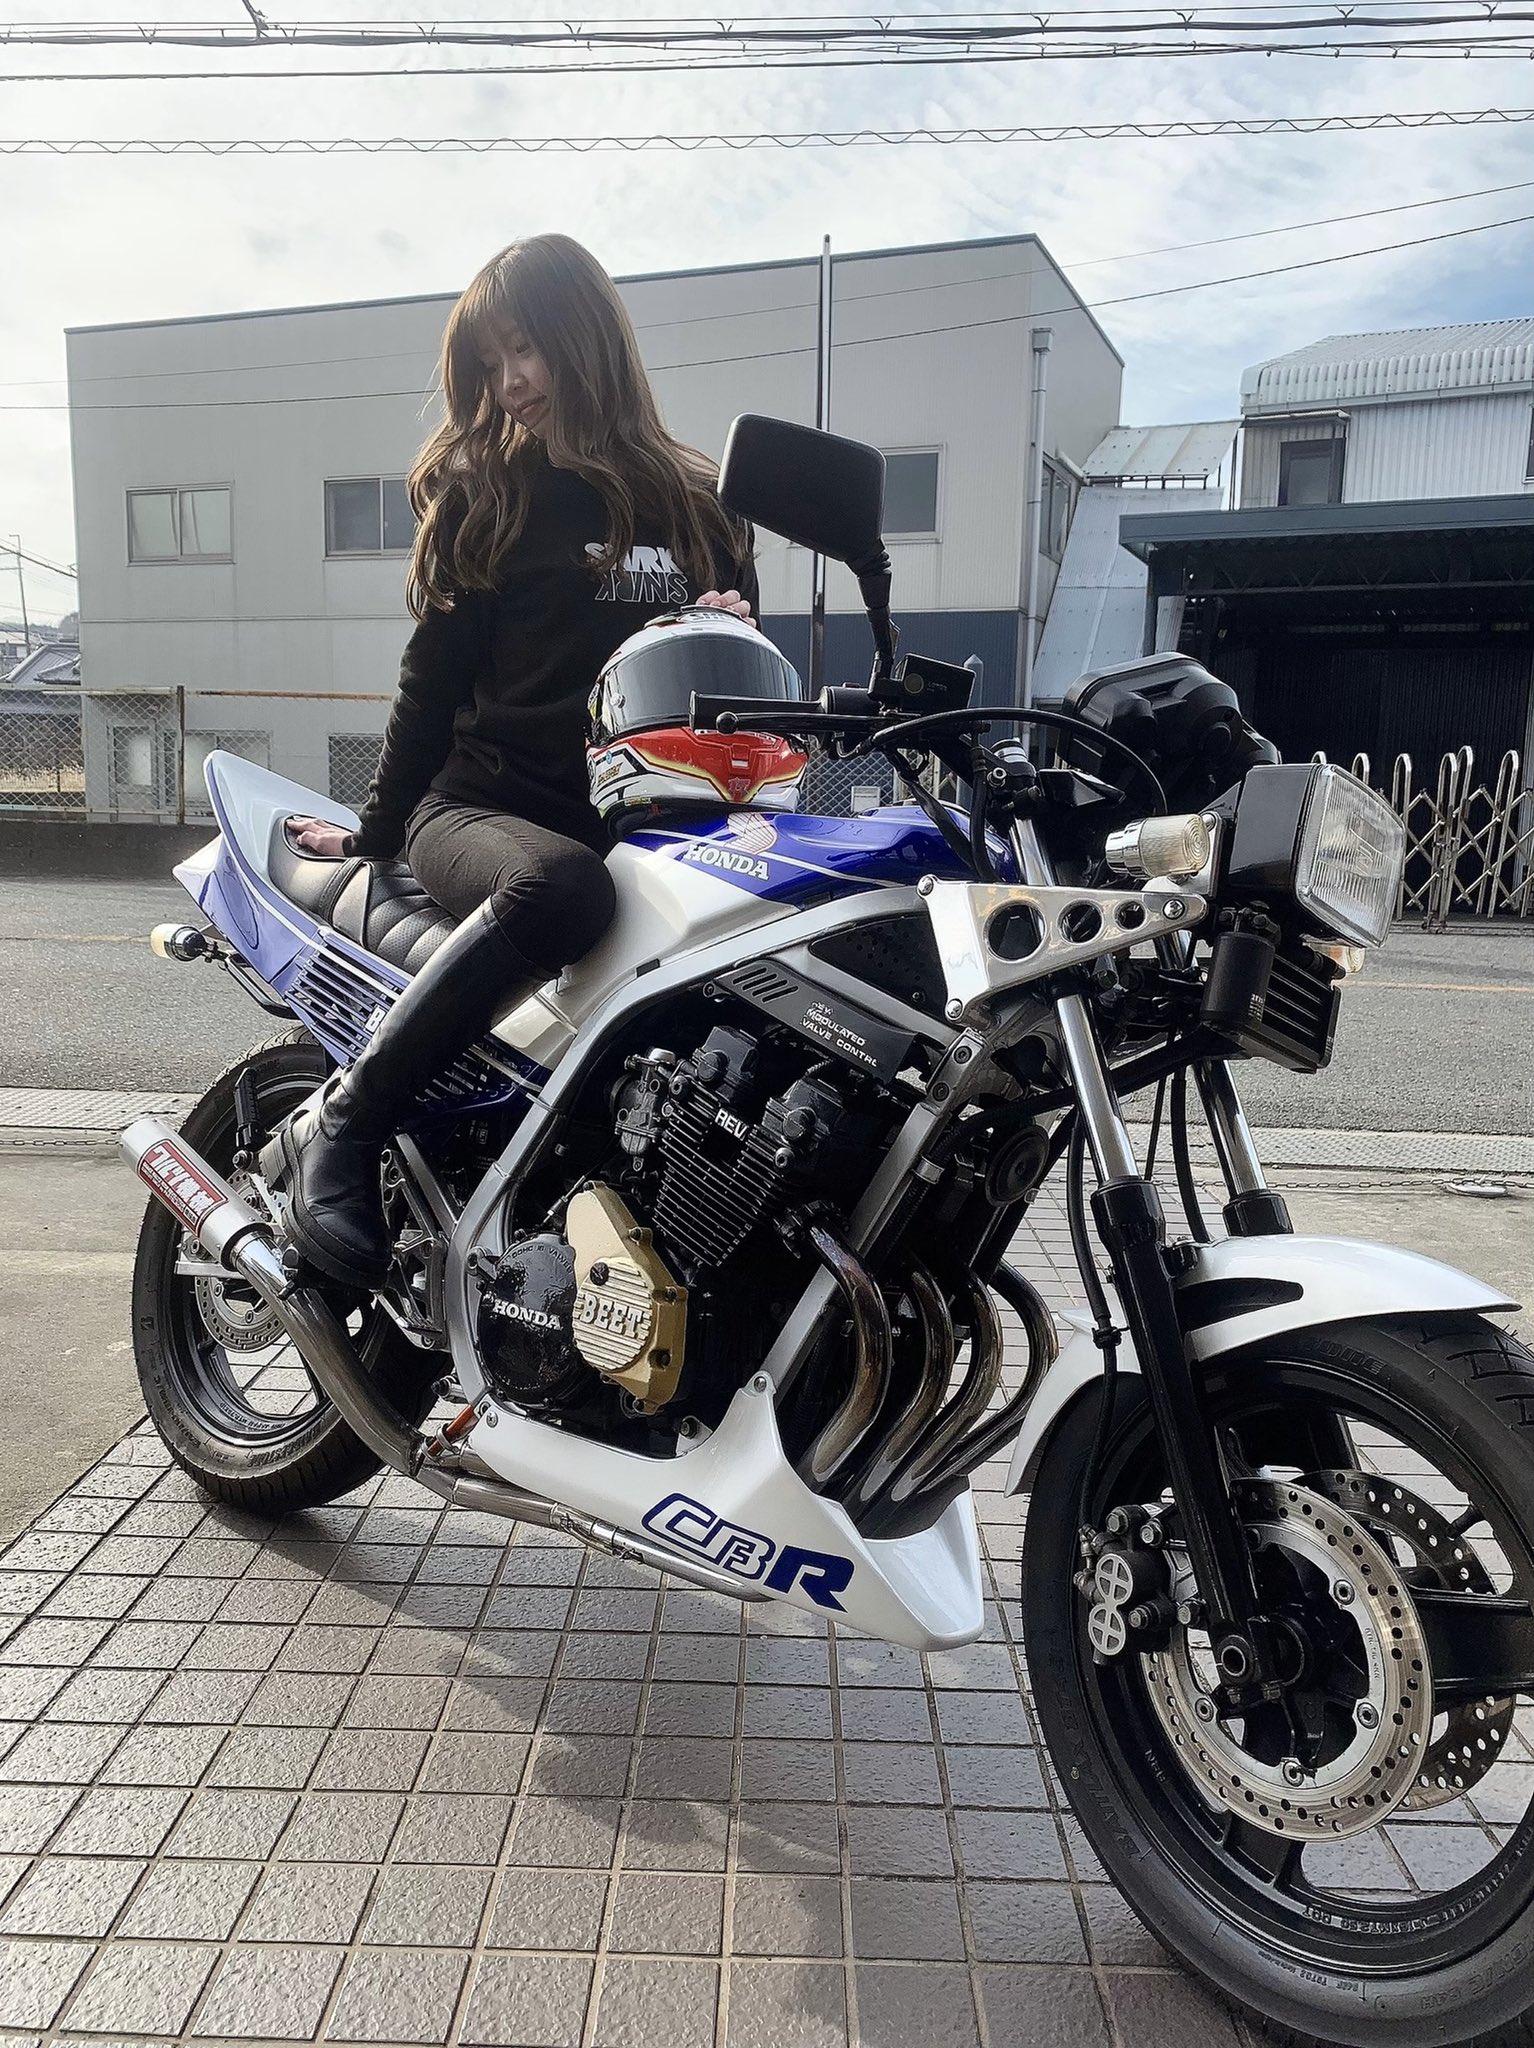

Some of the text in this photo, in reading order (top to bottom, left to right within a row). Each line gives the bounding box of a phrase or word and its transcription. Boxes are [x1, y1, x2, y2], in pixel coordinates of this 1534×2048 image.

[683, 844, 769, 881] HONDA
[802, 1019, 832, 1041] VALVE
[805, 1008, 867, 1047] MODULATED
[715, 1107, 749, 1140] REV
[493, 1300, 562, 1330] HONDA
[582, 1295, 643, 1338] BEET
[641, 1492, 855, 1613] CBR
